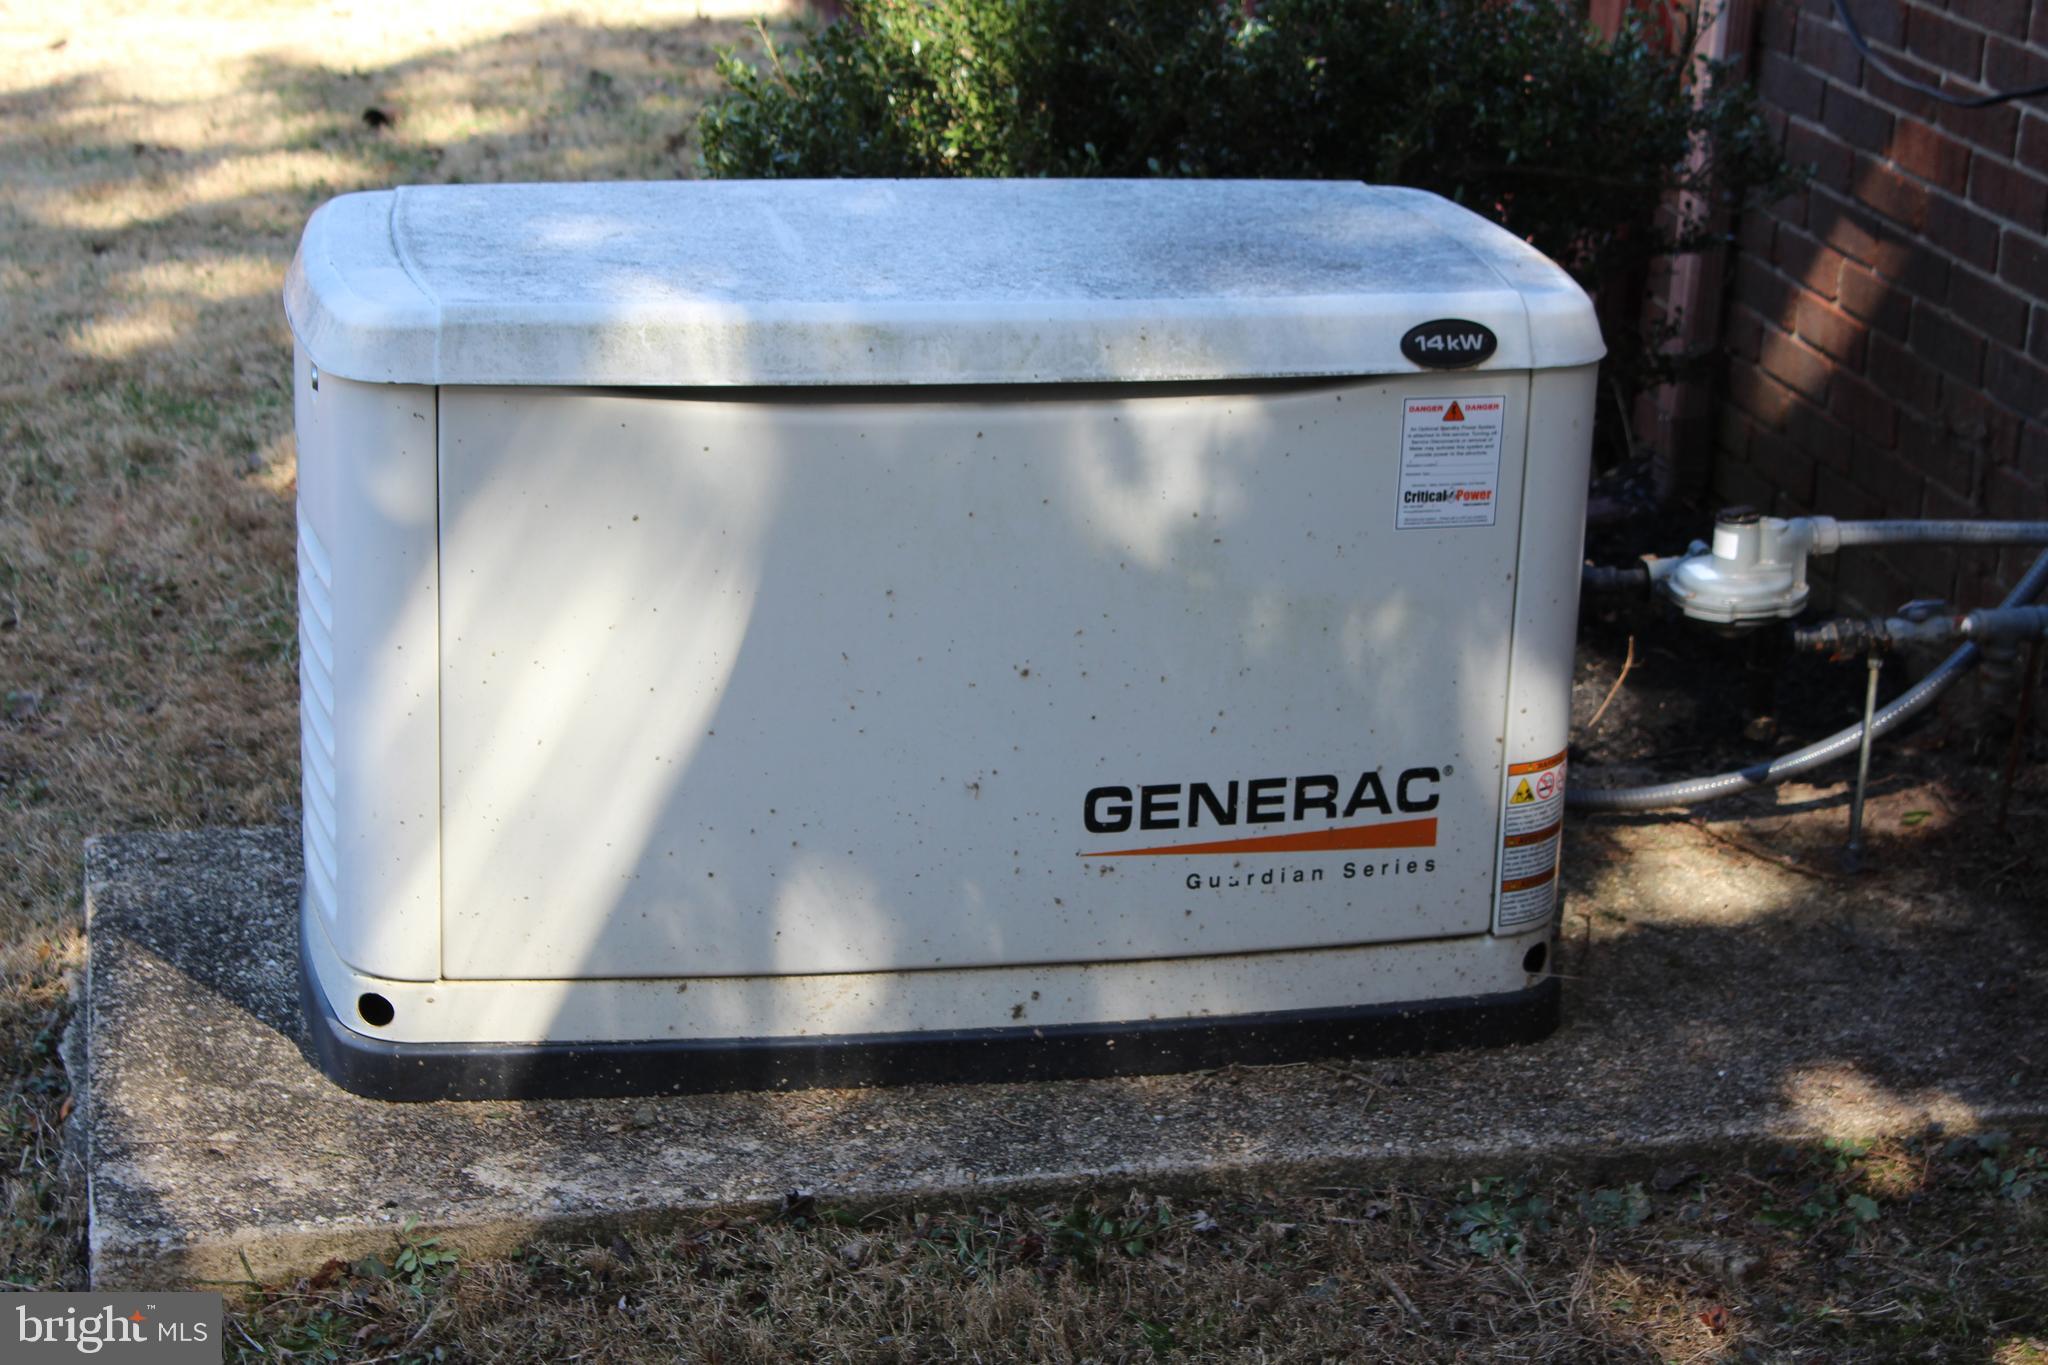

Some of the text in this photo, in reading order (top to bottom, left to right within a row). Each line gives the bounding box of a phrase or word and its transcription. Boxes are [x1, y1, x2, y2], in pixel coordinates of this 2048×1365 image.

[1414, 333, 1483, 351] 14kW
[1408, 403, 1500, 413] DANGER DANGER
[1404, 489, 1492, 503] Critical Power
[1083, 766, 1441, 834] GENERAC
[1343, 859, 1436, 879] Series
